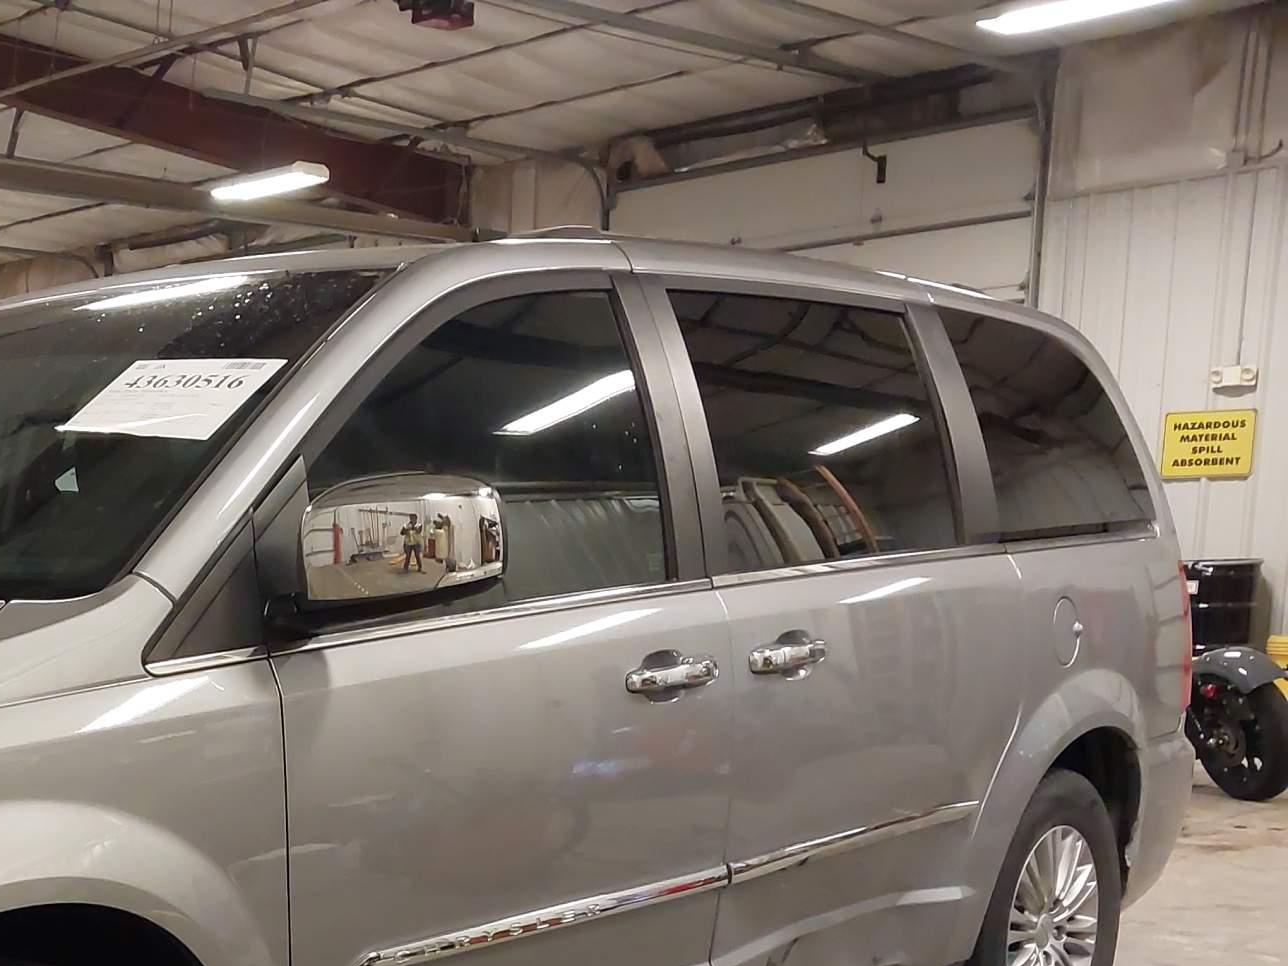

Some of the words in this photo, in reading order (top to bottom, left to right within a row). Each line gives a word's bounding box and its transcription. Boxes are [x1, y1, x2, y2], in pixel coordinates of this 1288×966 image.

[125, 374, 249, 389] 43630516
[1173, 420, 1246, 431] HAZARDOUS
[1179, 432, 1237, 443] MATERIAL
[1191, 445, 1223, 454] SPILL
[1172, 457, 1241, 467] ABSORBENT
[394, 903, 601, 963] CHRYSLER
